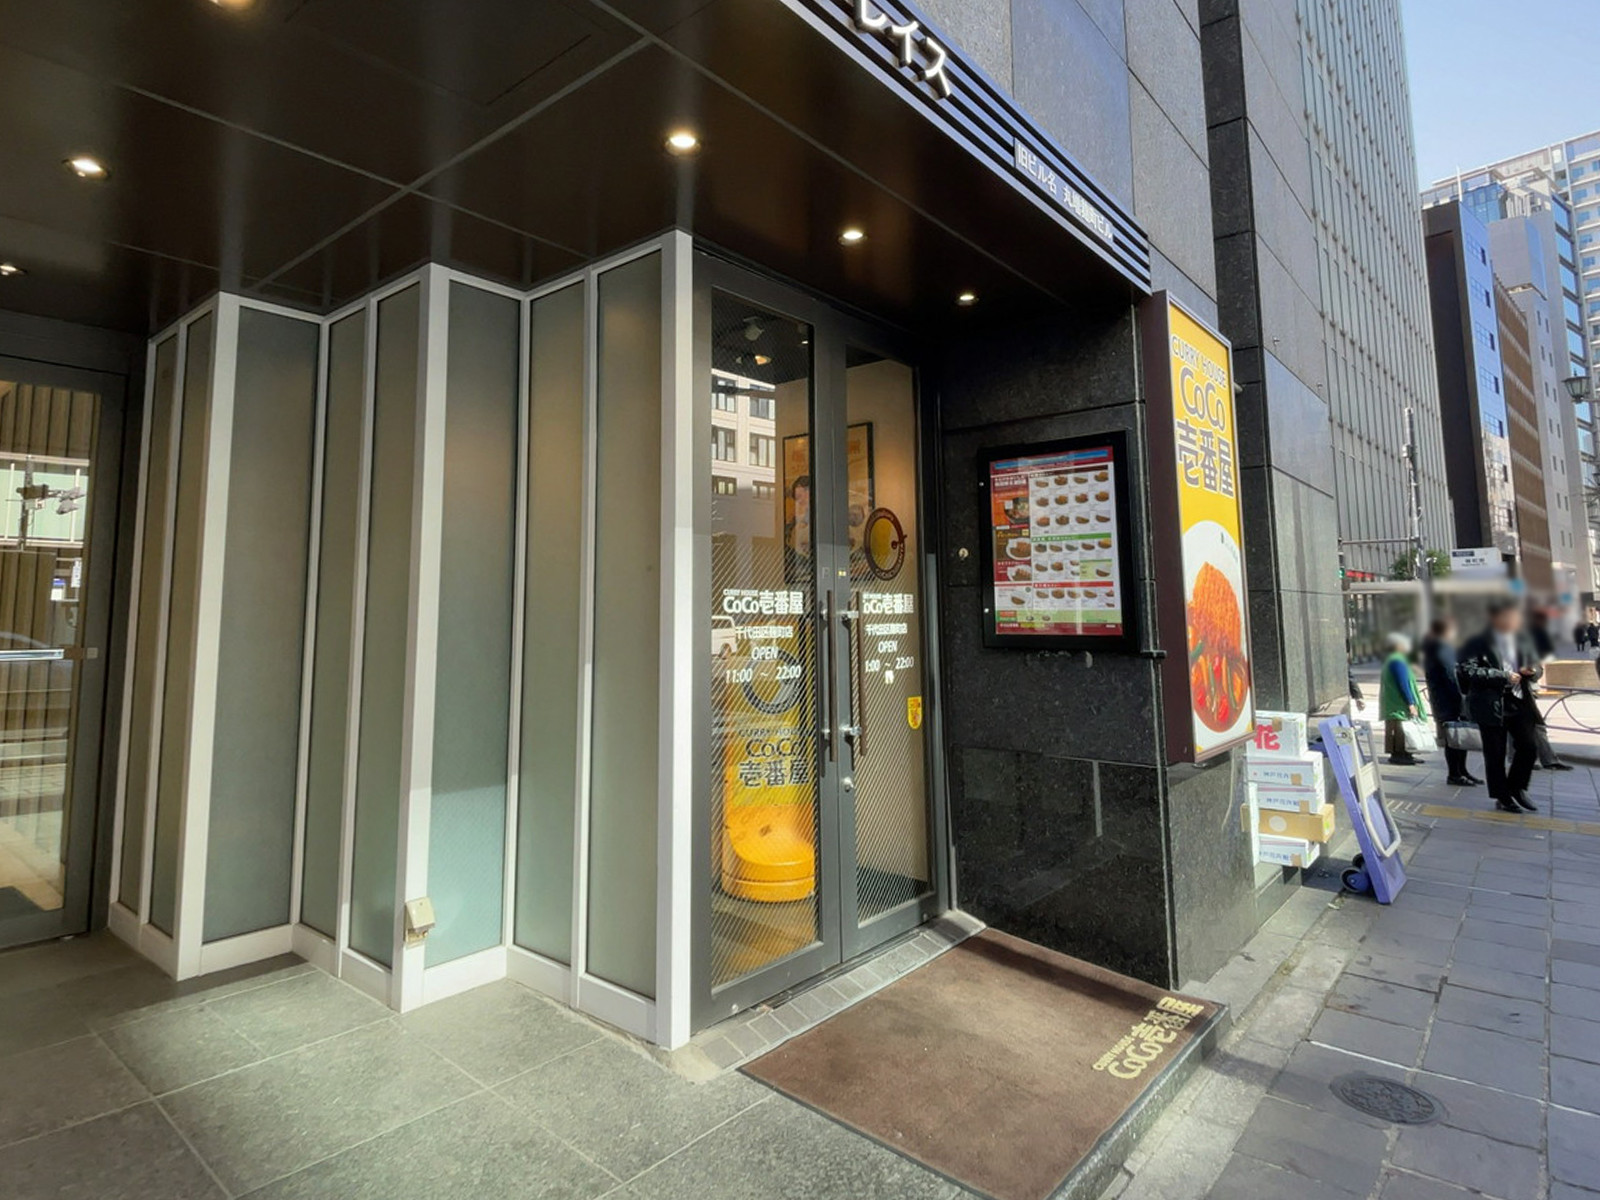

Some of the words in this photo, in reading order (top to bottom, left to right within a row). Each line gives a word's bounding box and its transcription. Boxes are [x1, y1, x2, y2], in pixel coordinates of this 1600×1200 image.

[1017, 143, 1057, 195] 旧ビル名
[1172, 335, 1200, 370] CURRY
[1201, 354, 1227, 389] HOUSE
[1180, 366, 1226, 431] CoCo
[1176, 418, 1234, 498] 壱番屋
[751, 646, 780, 660] OPEN
[878, 640, 899, 654] OPEN
[895, 656, 915, 670] 22:00
[725, 668, 753, 684] 11:00
[775, 665, 802, 680] 22:00
